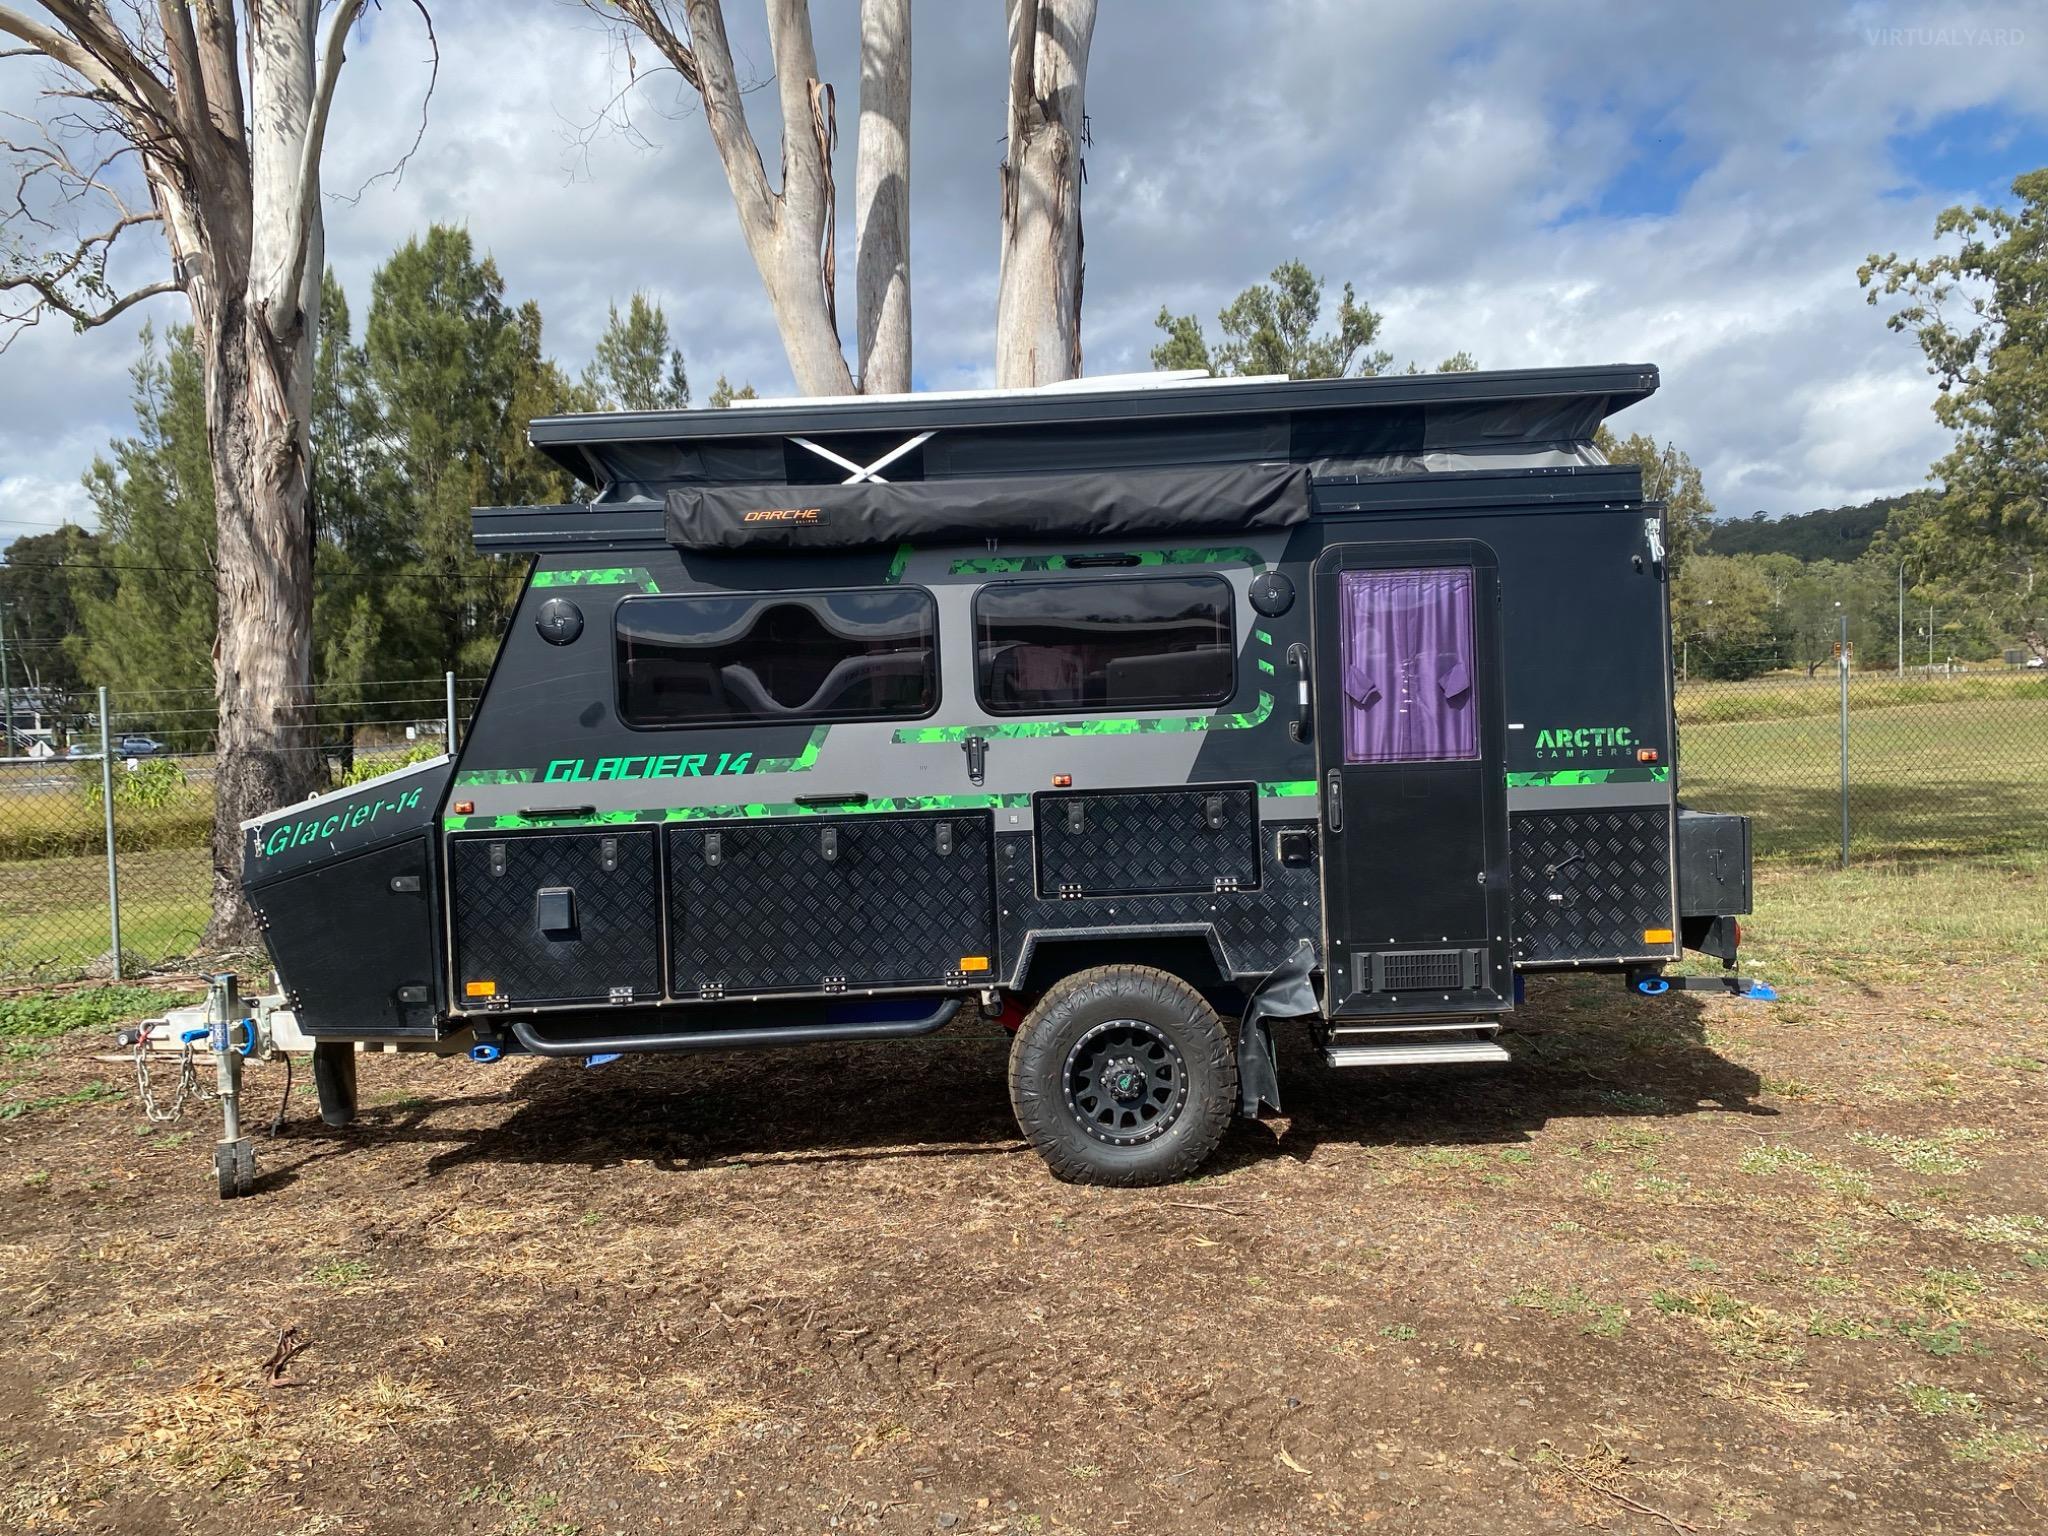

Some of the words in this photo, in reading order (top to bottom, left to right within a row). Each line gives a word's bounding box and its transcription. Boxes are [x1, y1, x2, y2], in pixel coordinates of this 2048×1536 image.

[744, 509, 820, 521] DARCHE
[1536, 748, 1632, 759] CAMPERS
[544, 753, 707, 783] GLACIER
[713, 752, 753, 777] 14
[266, 786, 424, 856] Glacier-14
